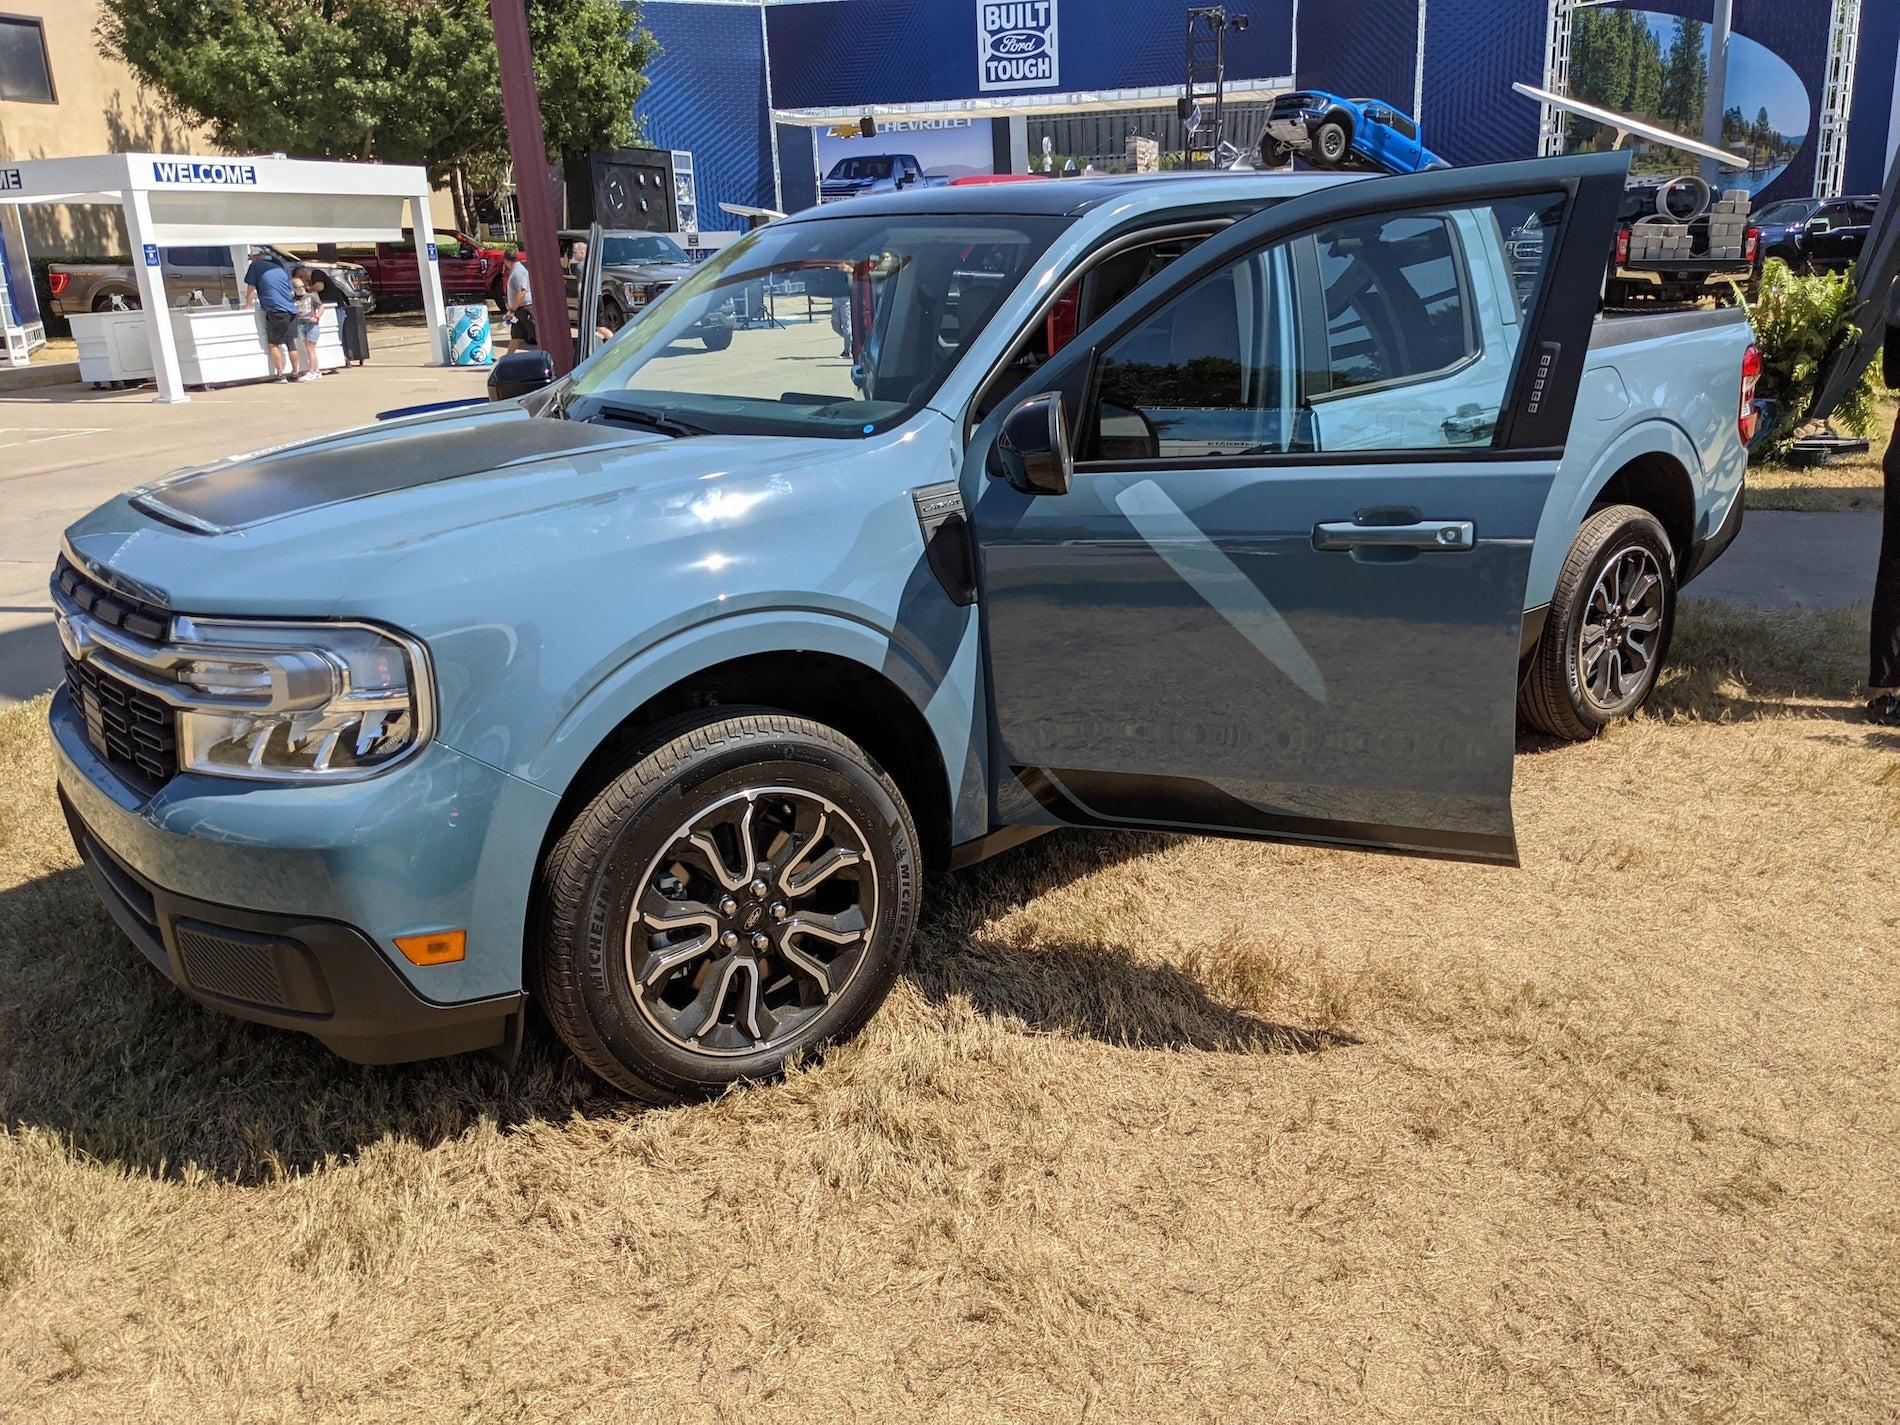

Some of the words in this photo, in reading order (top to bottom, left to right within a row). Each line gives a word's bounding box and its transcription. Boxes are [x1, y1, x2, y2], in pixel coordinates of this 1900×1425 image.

[985, 2, 1049, 31] BUILT
[1000, 35, 1036, 52] Ford
[986, 57, 1050, 81] TOUGH
[875, 118, 972, 133] CHEVROLET
[157, 163, 254, 184] WELCOME
[890, 863, 911, 958] MICHELIN
